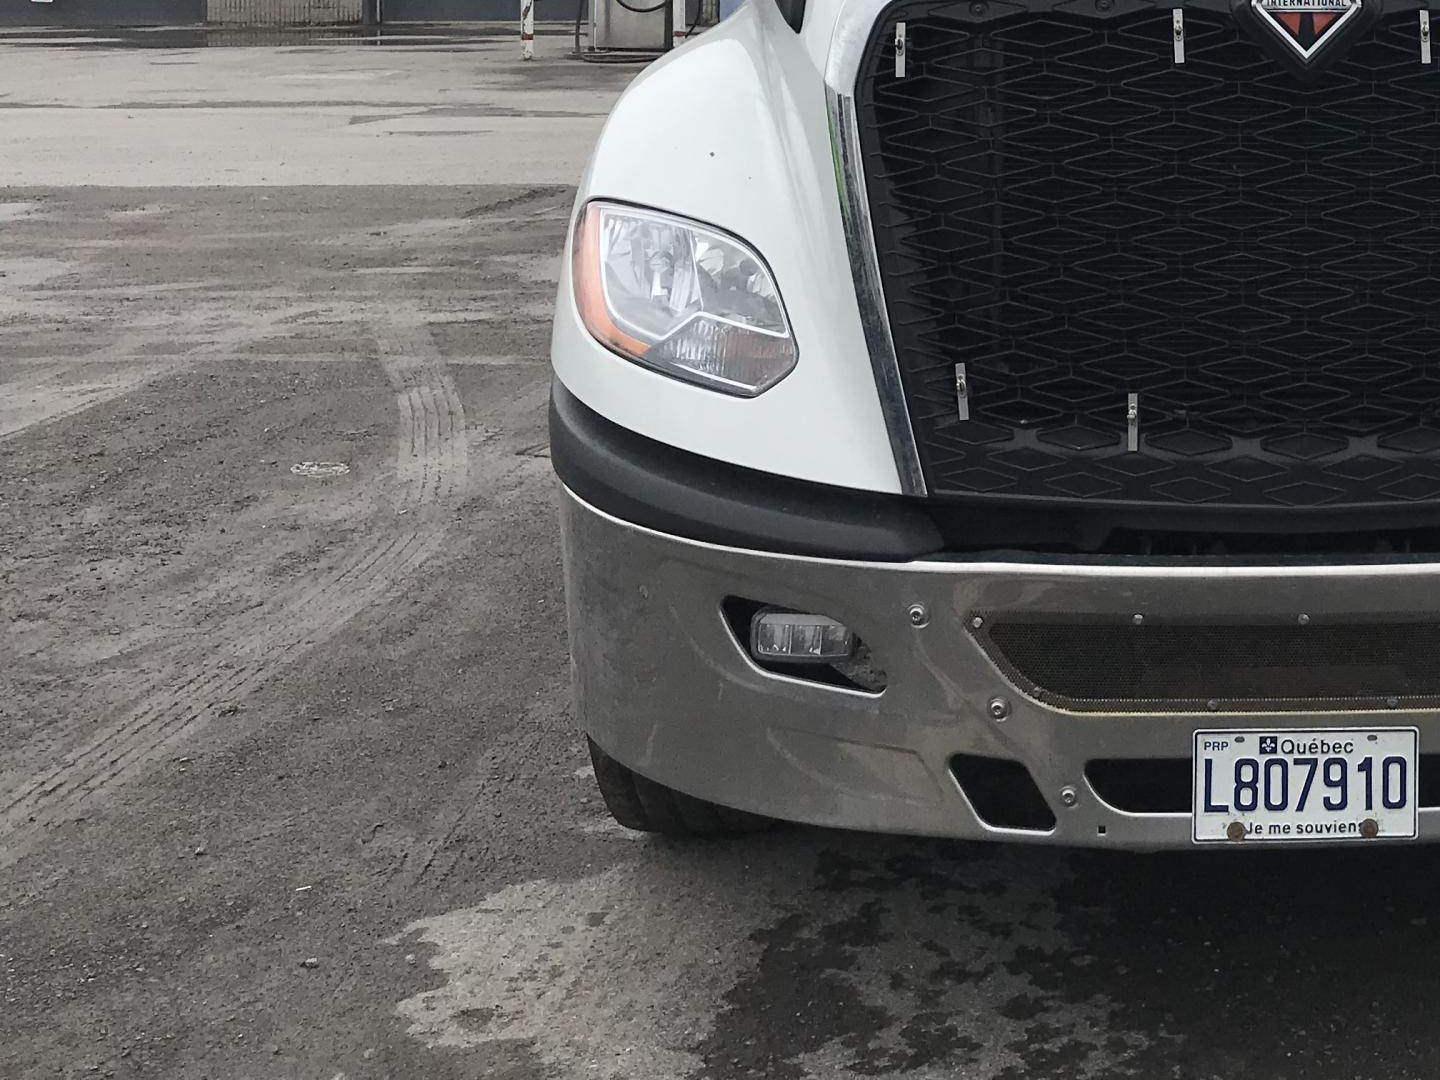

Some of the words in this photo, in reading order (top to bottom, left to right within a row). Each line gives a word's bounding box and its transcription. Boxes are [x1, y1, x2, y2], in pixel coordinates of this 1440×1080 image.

[1203, 741, 1229, 751] PRP
[1280, 737, 1354, 755] Québec
[1203, 756, 1407, 813] L807910
[1244, 822, 1264, 835] Je
[1268, 824, 1291, 835] me
